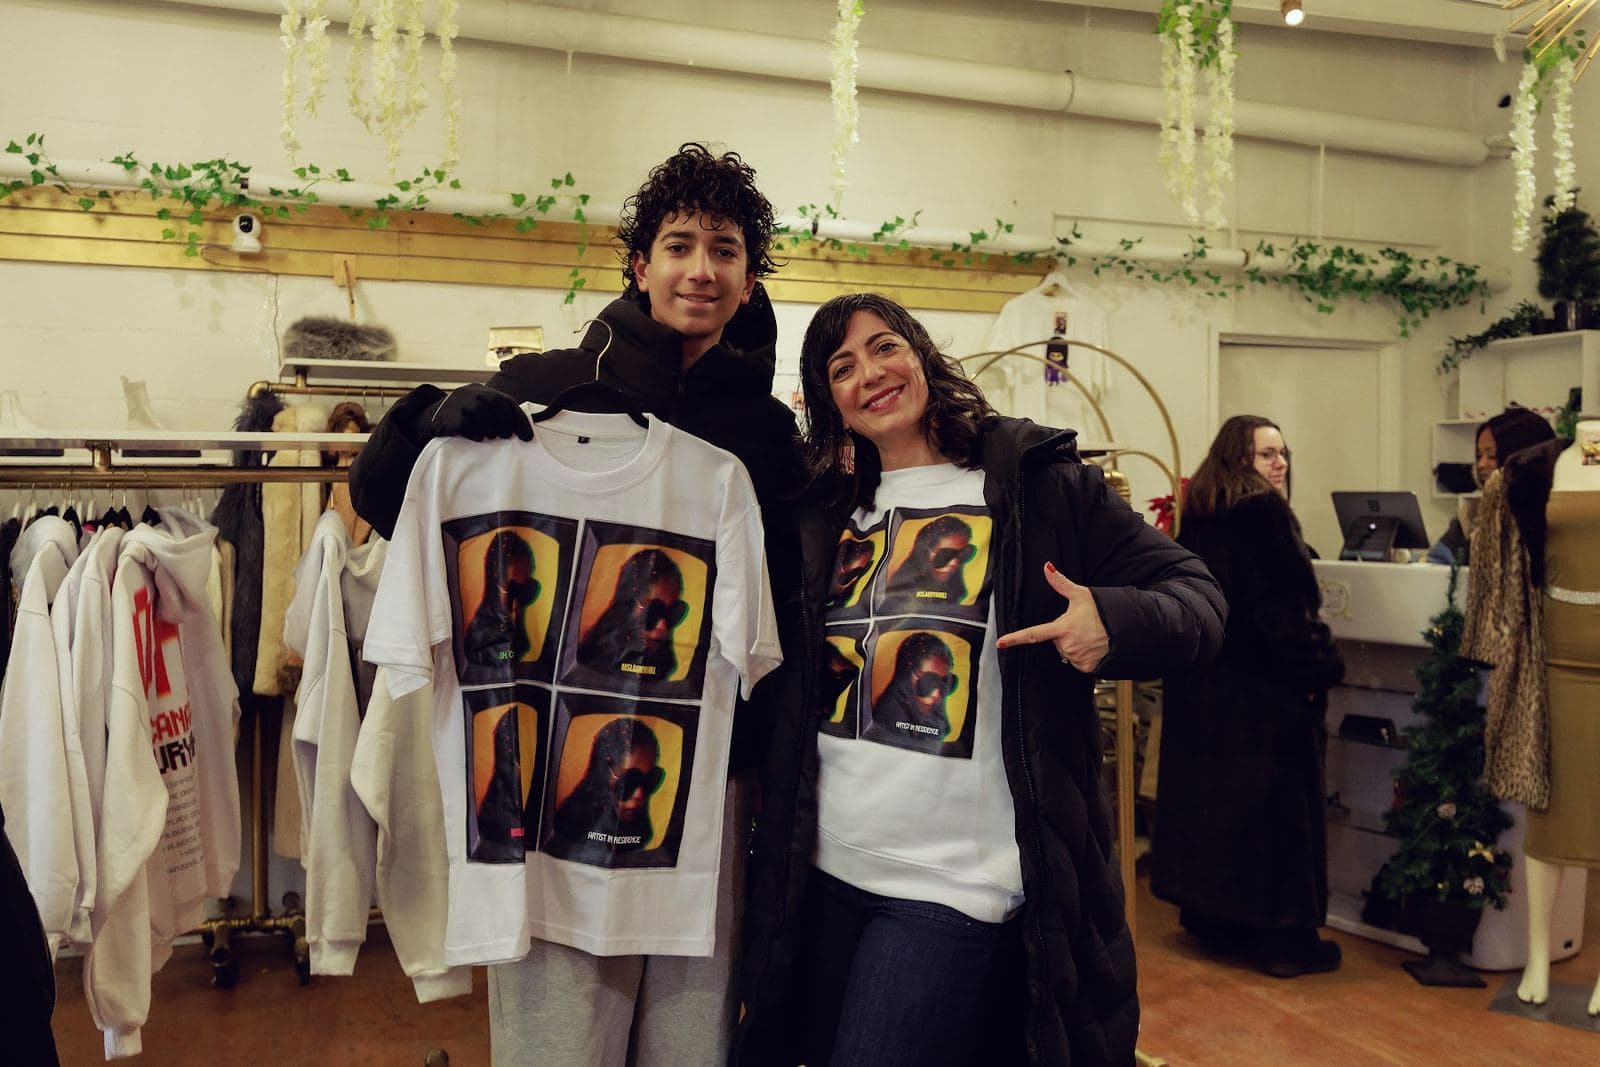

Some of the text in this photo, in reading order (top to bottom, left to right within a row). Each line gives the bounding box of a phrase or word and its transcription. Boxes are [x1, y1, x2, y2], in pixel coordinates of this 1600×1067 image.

[587, 831, 641, 844] ARTIST IN RESIDENCE
